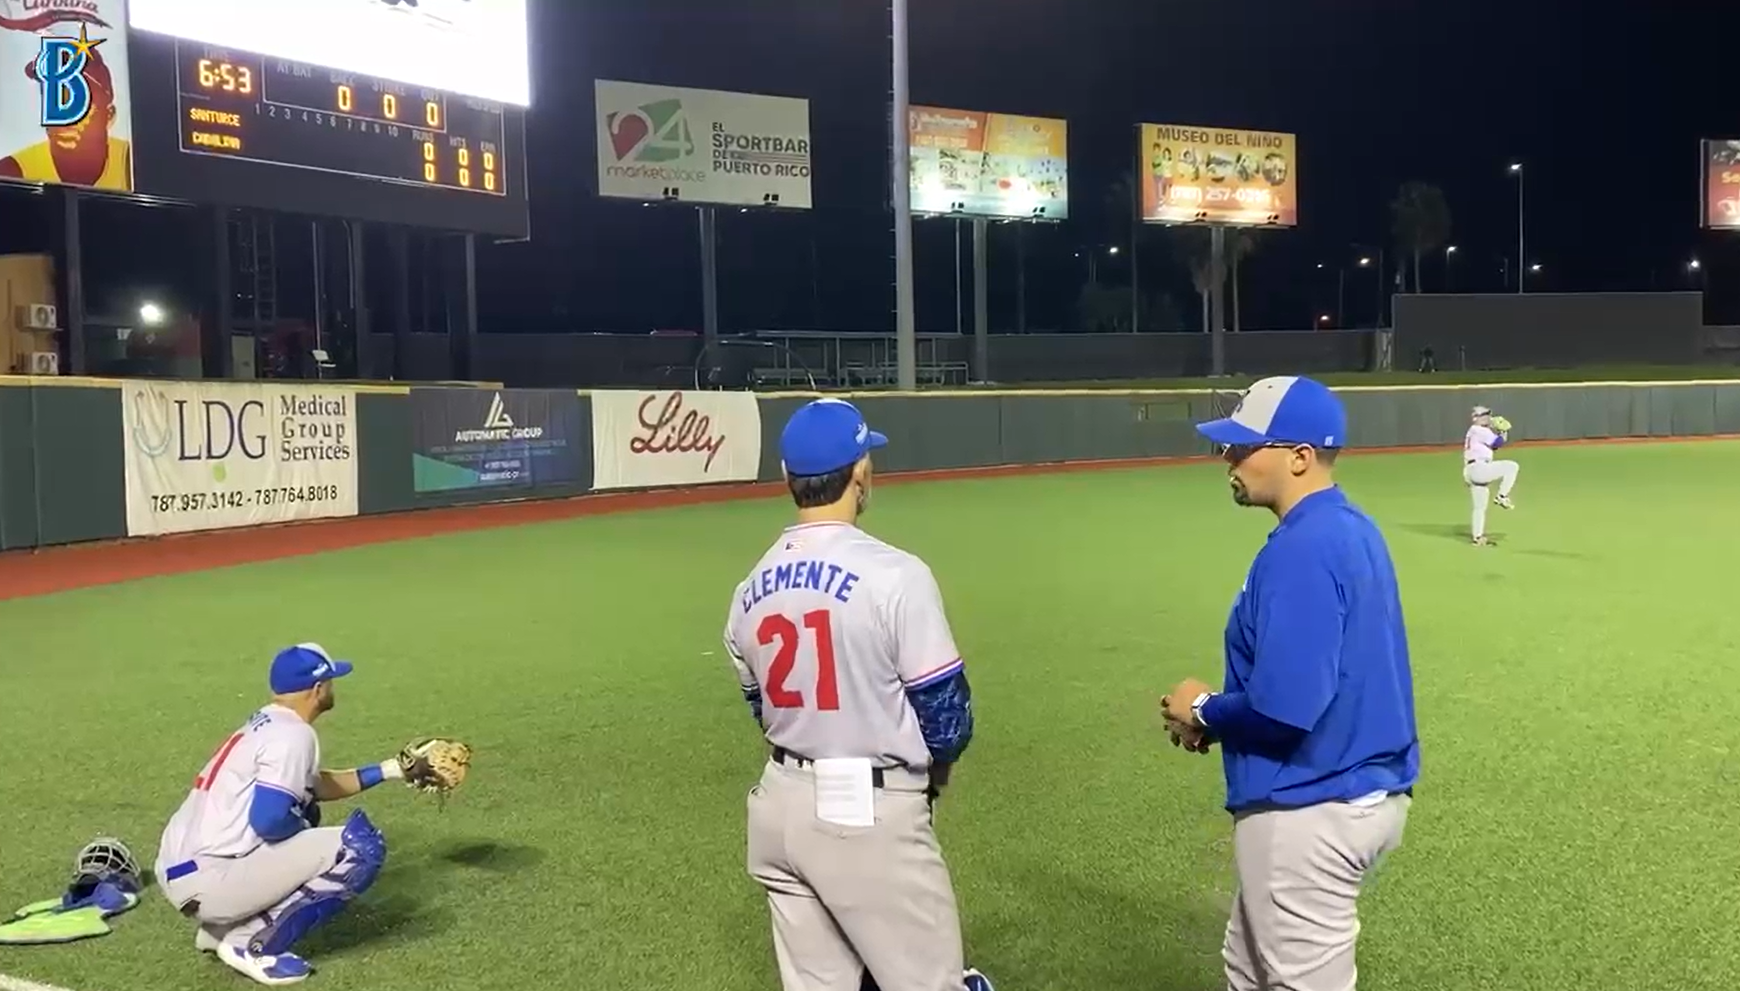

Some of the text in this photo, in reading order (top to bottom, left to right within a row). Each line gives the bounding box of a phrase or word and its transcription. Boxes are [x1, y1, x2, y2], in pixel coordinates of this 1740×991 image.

[199, 59, 252, 93] 6:53
[337, 85, 351, 111] 0
[383, 92, 396, 119] 0
[255, 103, 260, 115] 1
[268, 105, 276, 118] 2
[283, 107, 291, 120] 3
[301, 110, 308, 122] 4
[315, 113, 323, 125] 5
[329, 115, 336, 127] 6
[387, 124, 399, 138] 10
[426, 101, 438, 127] 0
[712, 122, 725, 133] EL
[1156, 127, 1209, 144] MUSEO
[1214, 133, 1240, 146] DEL
[423, 142, 494, 171] 0 0 0
[712, 133, 808, 154] SPORTBAR
[424, 162, 495, 191] 0 0 0
[713, 160, 810, 178] PUERTO RICO
[280, 395, 347, 416] Medical
[174, 400, 266, 461] LDG
[281, 417, 346, 444] Group
[455, 427, 543, 442] AUTOMATIC GROUP
[630, 390, 726, 473] Lilly
[281, 440, 350, 462] Services
[152, 490, 243, 512] 787.957.3142
[742, 560, 860, 615] CLEMENTE
[757, 609, 840, 710] 21
